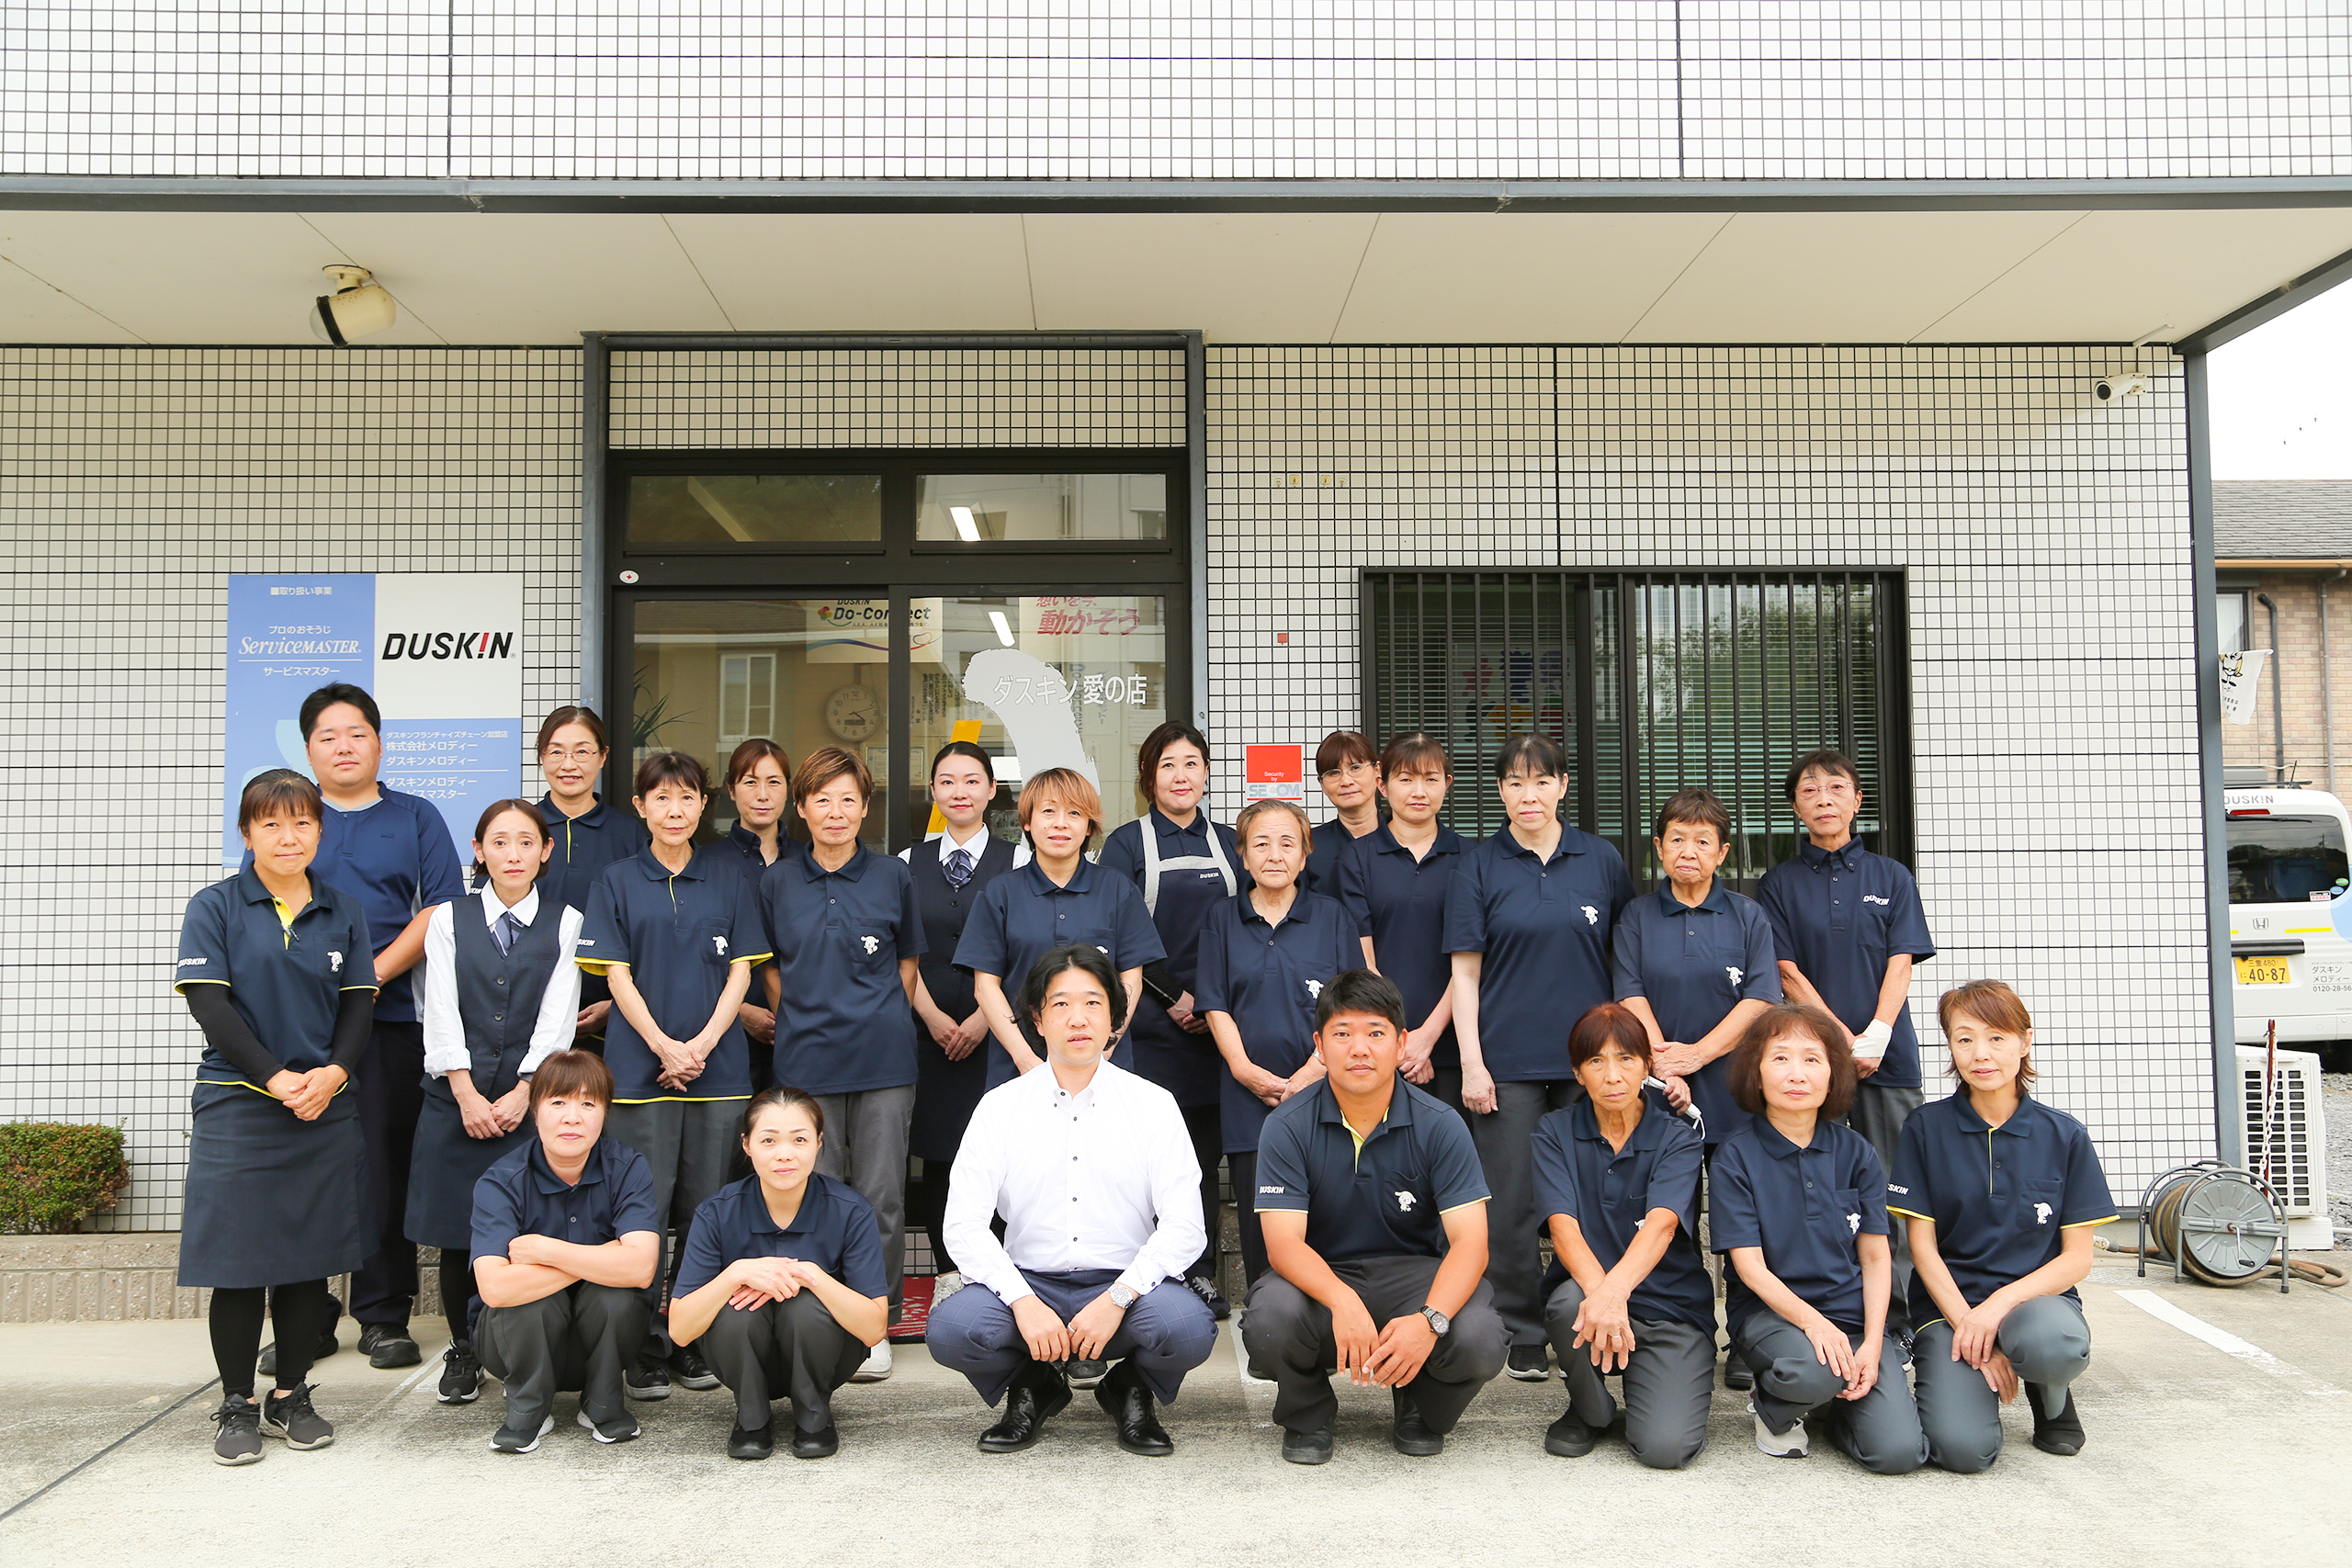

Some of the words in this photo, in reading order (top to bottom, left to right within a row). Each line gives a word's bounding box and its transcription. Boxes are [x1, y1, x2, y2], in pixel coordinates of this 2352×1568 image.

[278, 587, 333, 595] 取り扱い事業
[1037, 609, 1140, 636] 動かそう
[269, 626, 331, 635] プロのおそうじ
[263, 667, 340, 676] サービスマスター
[386, 740, 478, 751] 株式会社メロディー
[386, 756, 478, 766] ダスキンメロディー
[386, 776, 478, 787] ダスキンメロディー
[577, 938, 596, 947] SKIN
[2249, 967, 2286, 982] 40-87
[2312, 965, 2342, 974] ダスキン
[1887, 1183, 1909, 1195] SKIN
